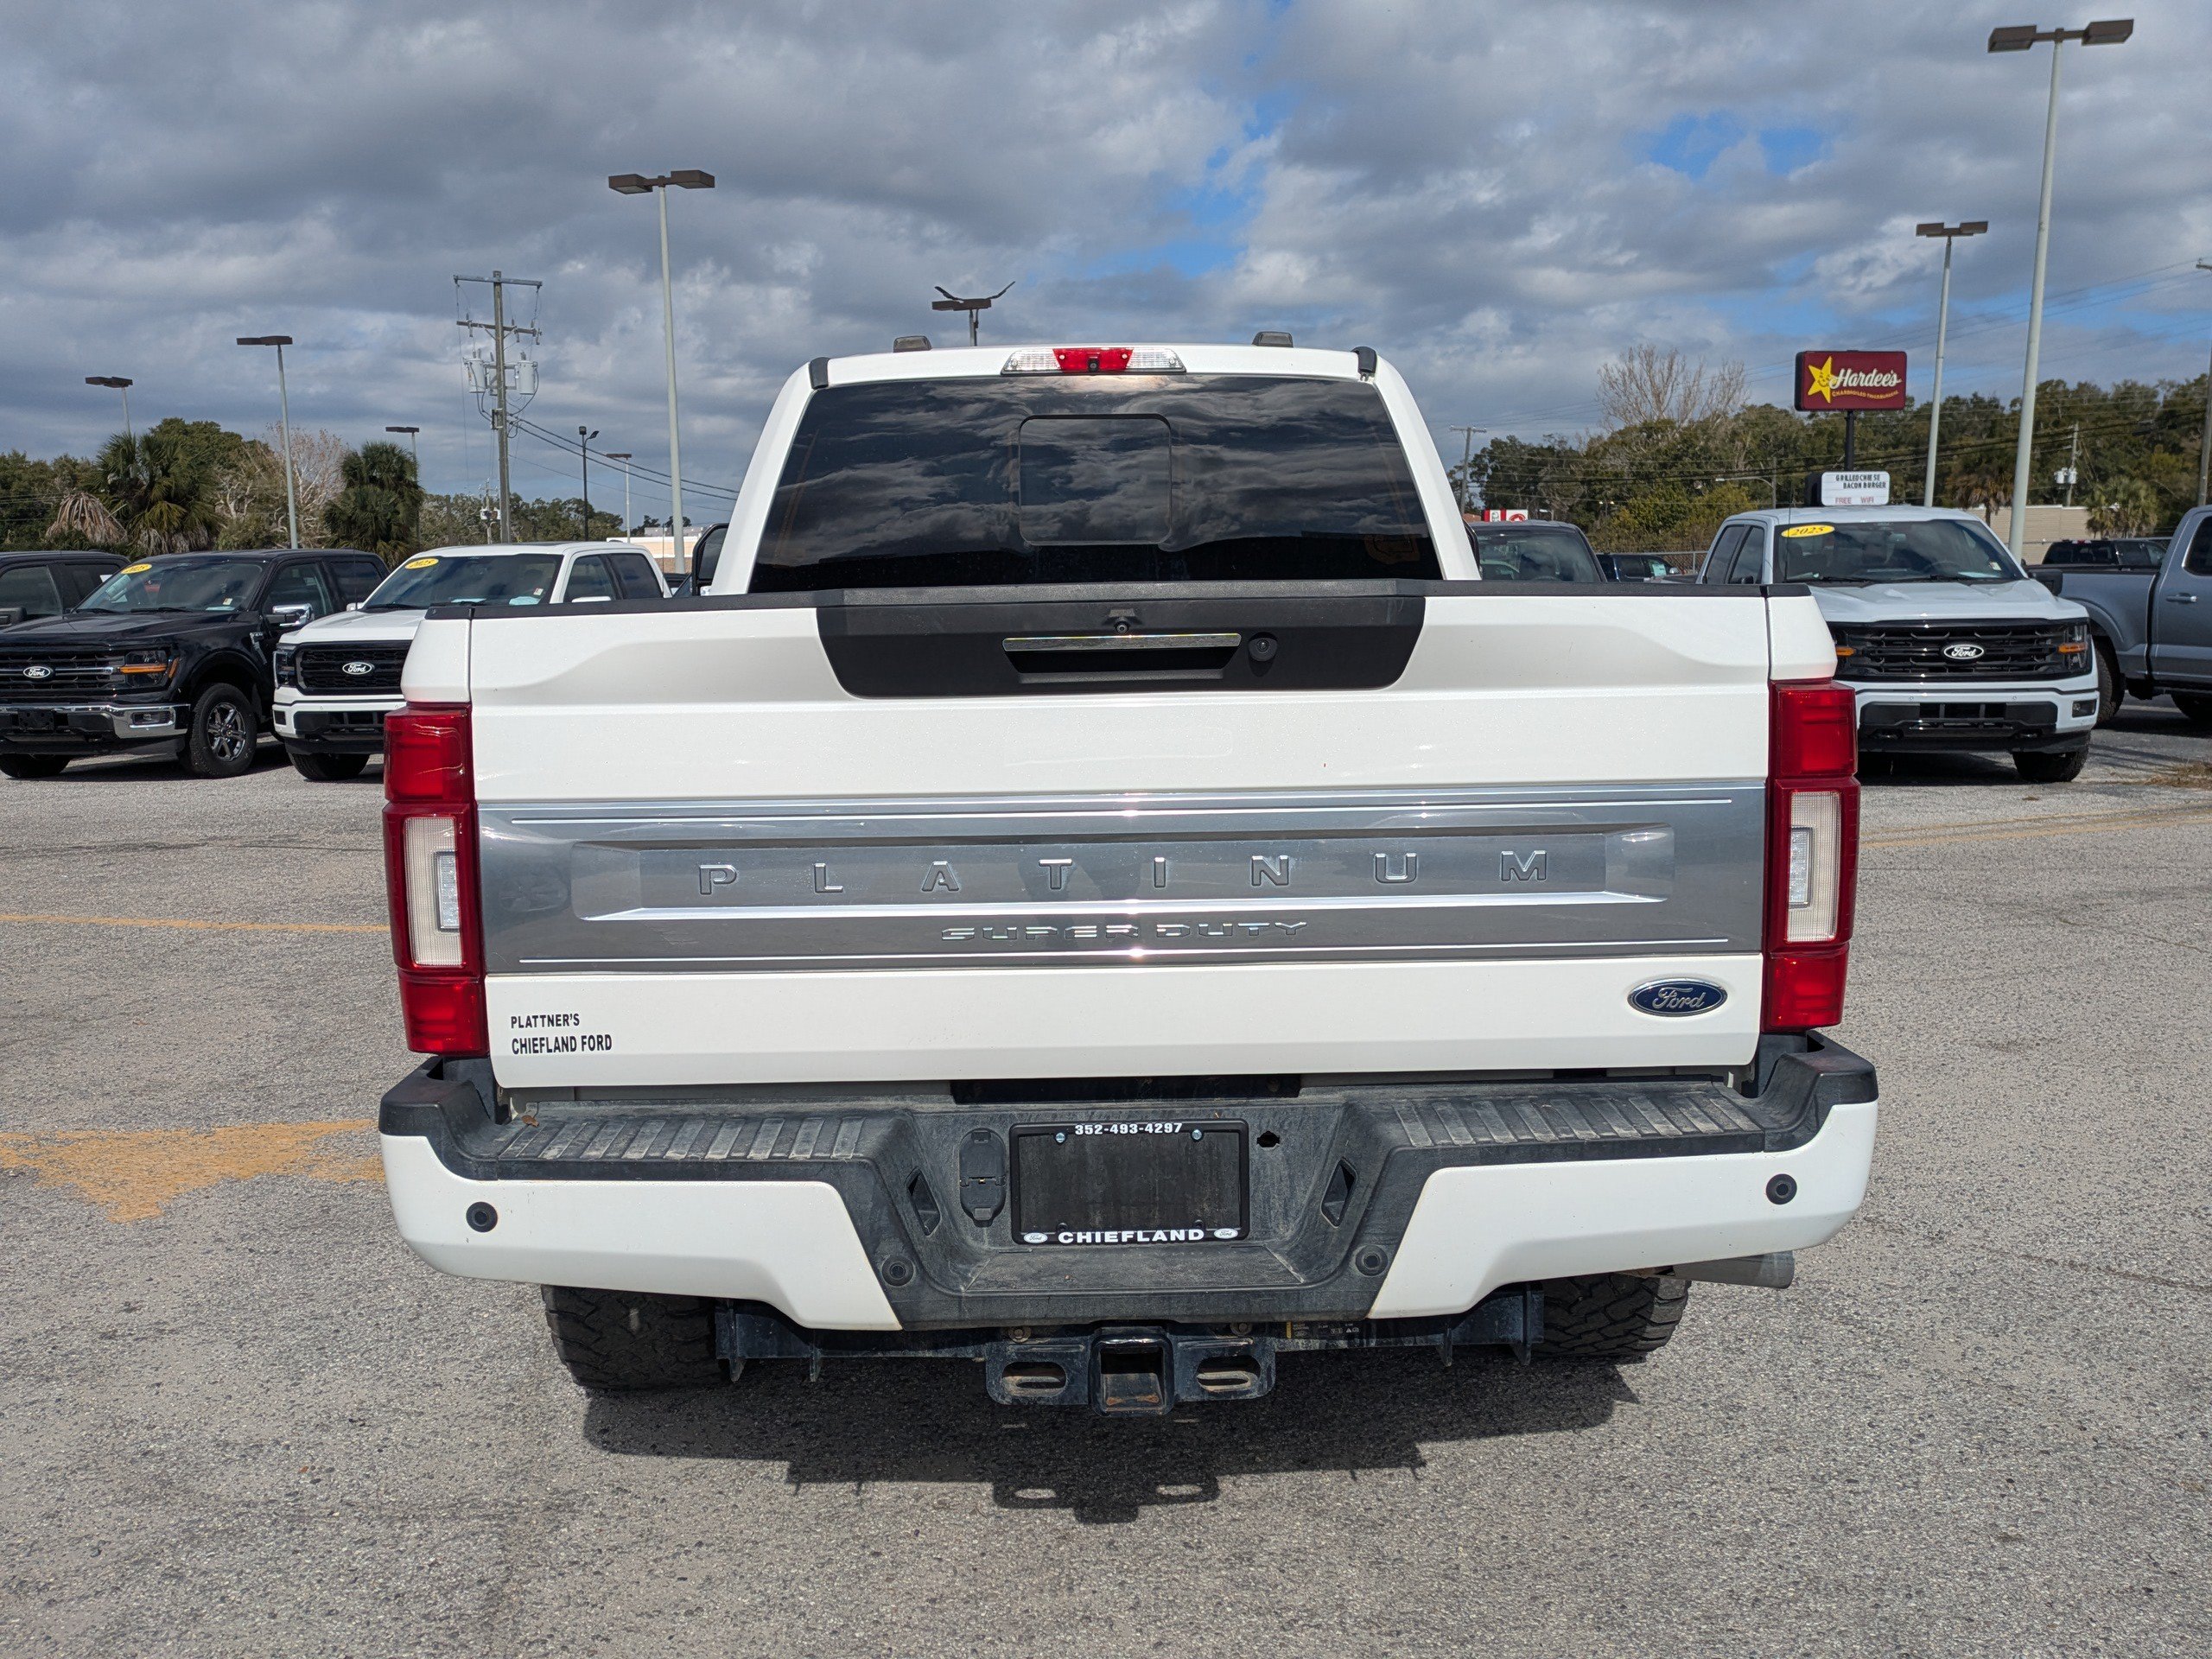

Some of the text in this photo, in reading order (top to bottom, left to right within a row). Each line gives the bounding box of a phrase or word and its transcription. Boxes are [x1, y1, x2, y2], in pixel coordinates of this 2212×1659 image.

[1828, 368, 1902, 389] Hardee's
[1791, 526, 1825, 536] 2025
[1951, 646, 1977, 657] Ford
[29, 667, 46, 677] Ford
[347, 664, 366, 672] Ford
[699, 850, 1548, 895] PLATINUM
[941, 921, 1307, 941] SUPER DUTY
[1651, 987, 1707, 1009] Ford
[511, 1013, 580, 1028] PLATTNER'S
[512, 1033, 612, 1055] CHIEFLAND FORD
[1075, 1122, 1183, 1135] 352-493-4297
[1058, 1229, 1205, 1244] CHIEFLAND
